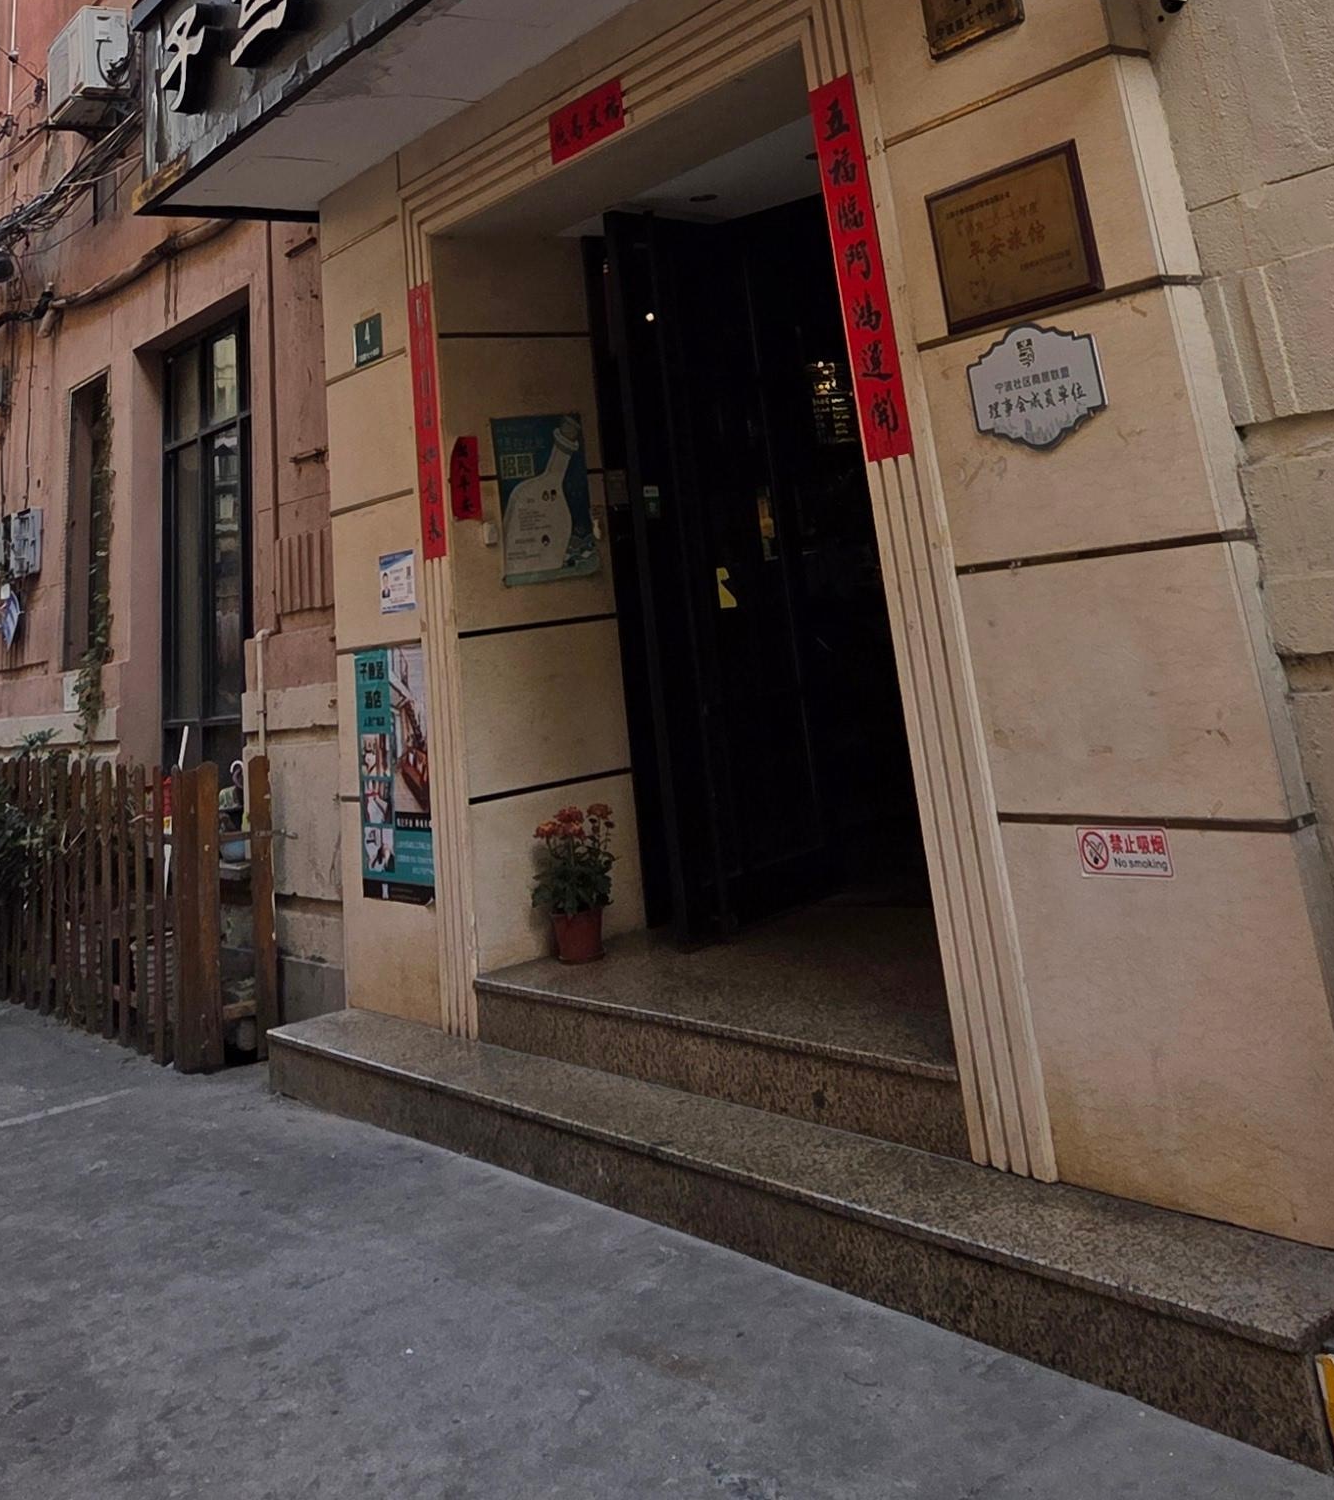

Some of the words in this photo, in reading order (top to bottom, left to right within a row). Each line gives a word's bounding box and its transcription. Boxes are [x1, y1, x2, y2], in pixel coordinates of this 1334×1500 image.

[1109, 833, 1167, 856] 禁止吸烟
[1113, 858, 1127, 869] No
[1129, 859, 1169, 872] smoking
